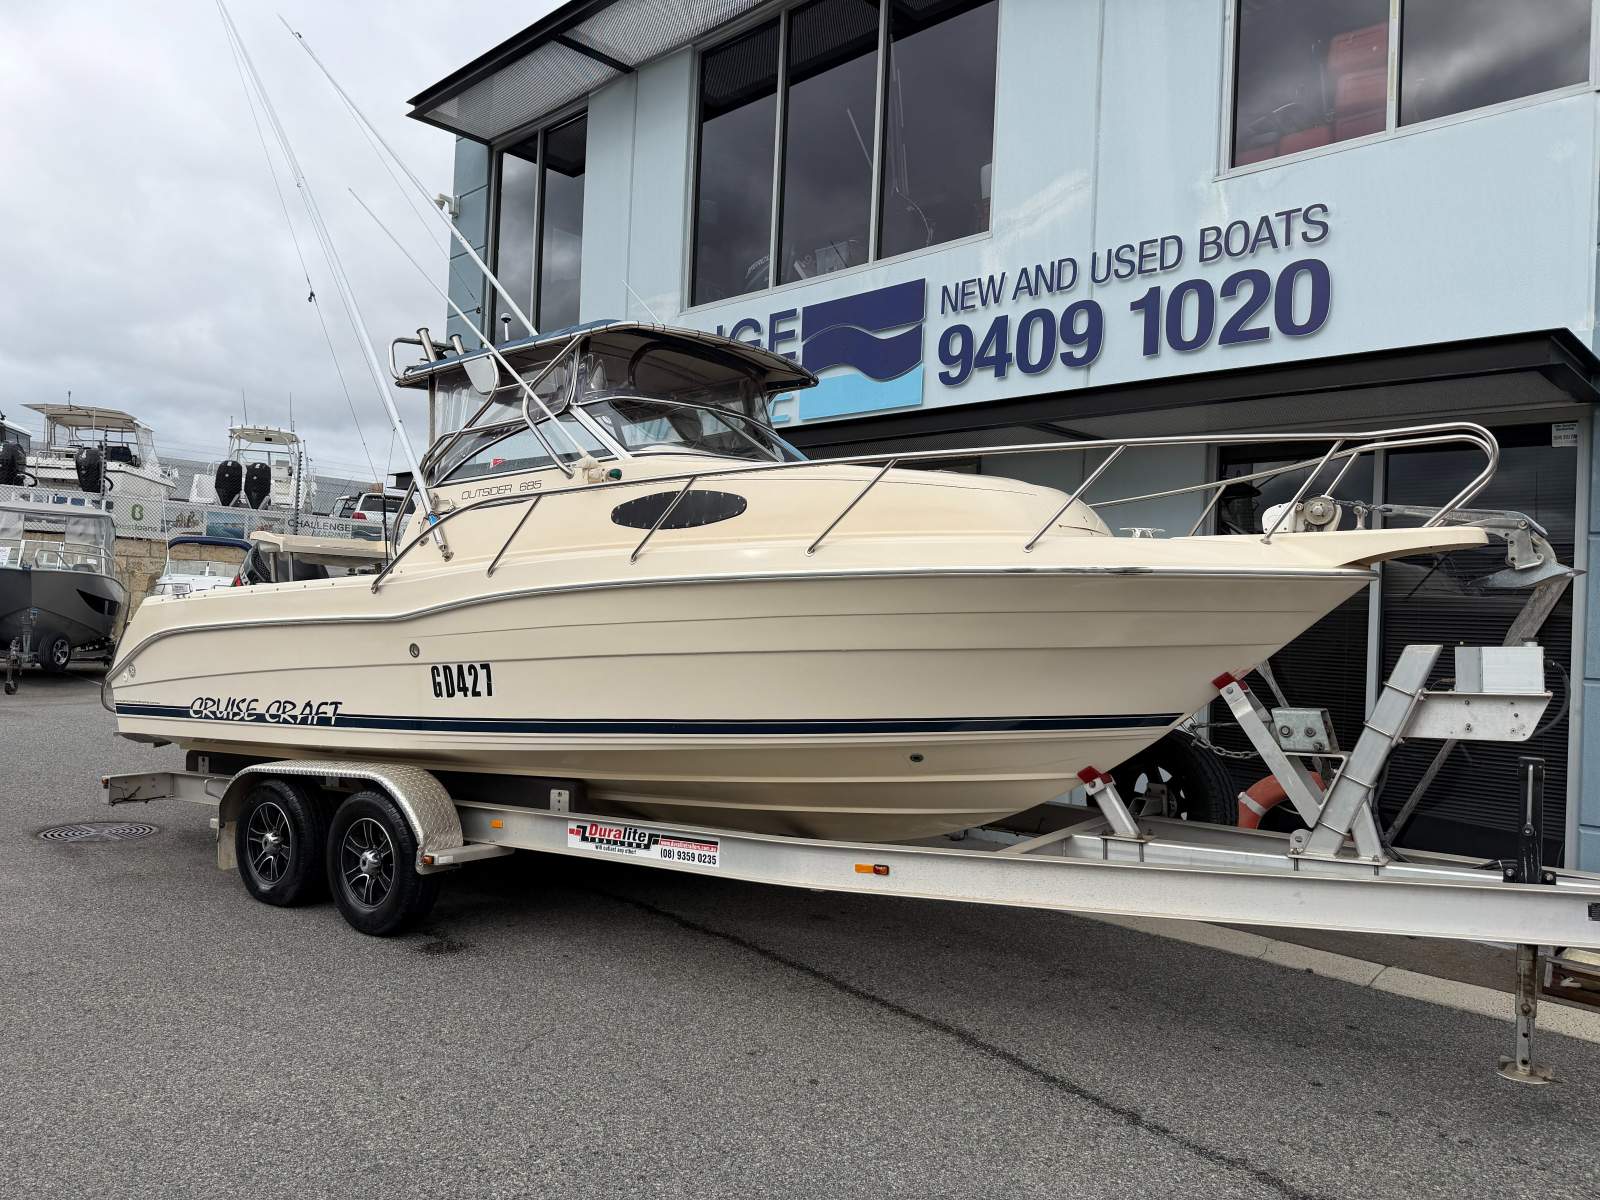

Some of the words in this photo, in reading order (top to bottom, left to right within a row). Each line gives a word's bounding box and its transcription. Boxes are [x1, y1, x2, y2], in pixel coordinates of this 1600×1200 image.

[940, 270, 1007, 315] NEW
[1011, 257, 1078, 301] AND
[1090, 234, 1183, 285] USED
[1198, 202, 1330, 264] BOATS
[938, 299, 1105, 388] 9409
[1130, 258, 1331, 358] 1020
[461, 483, 513, 500] OUTSIDER
[287, 518, 350, 532] CHALLENGE
[430, 663, 493, 698] GD427
[189, 696, 259, 721] CRUISE
[264, 699, 343, 726] CRAFT
[588, 823, 647, 843] Duralite
[660, 848, 675, 860] (08)
[677, 850, 696, 862] 9359
[697, 853, 717, 865] 0235
